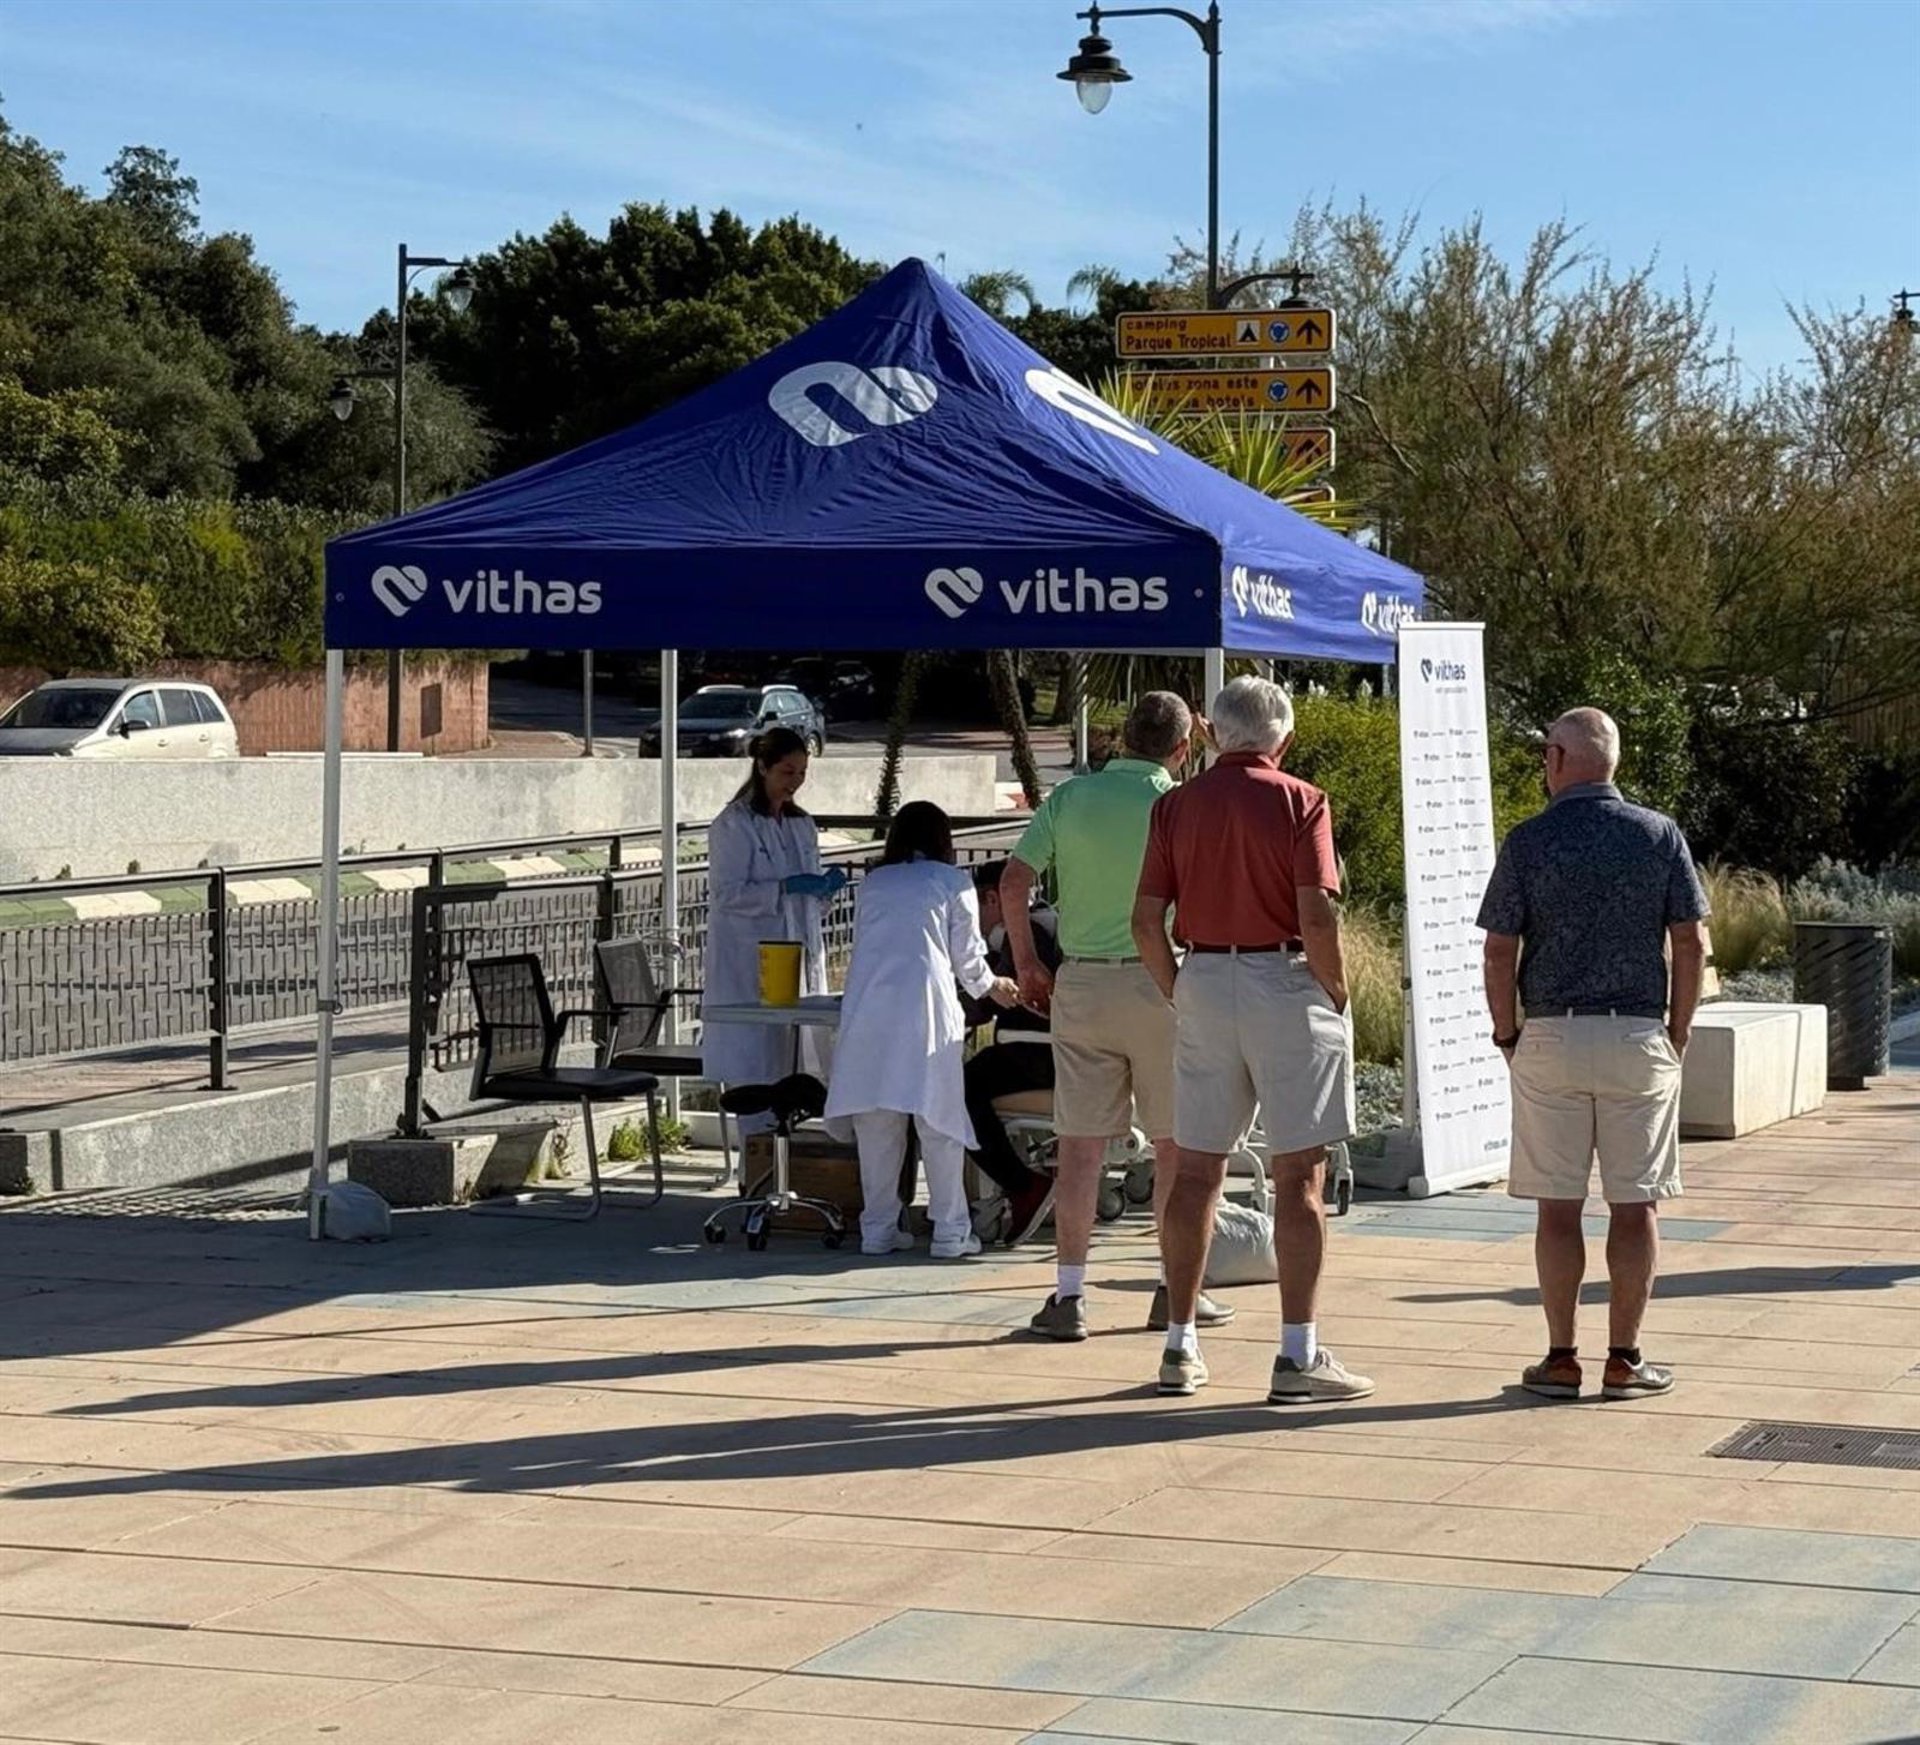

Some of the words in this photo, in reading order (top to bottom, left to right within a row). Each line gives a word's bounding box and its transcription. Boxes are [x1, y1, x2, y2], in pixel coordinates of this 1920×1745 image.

[1126, 318, 1187, 331] camping
[1126, 335, 1172, 351] Parque
[1177, 333, 1231, 350] Tropical
[1187, 378, 1219, 390] zona
[1227, 376, 1258, 389] este
[442, 570, 602, 614] vithas
[999, 567, 1169, 614] vithas
[1250, 575, 1295, 619] vithas
[1435, 659, 1466, 681] vithas
